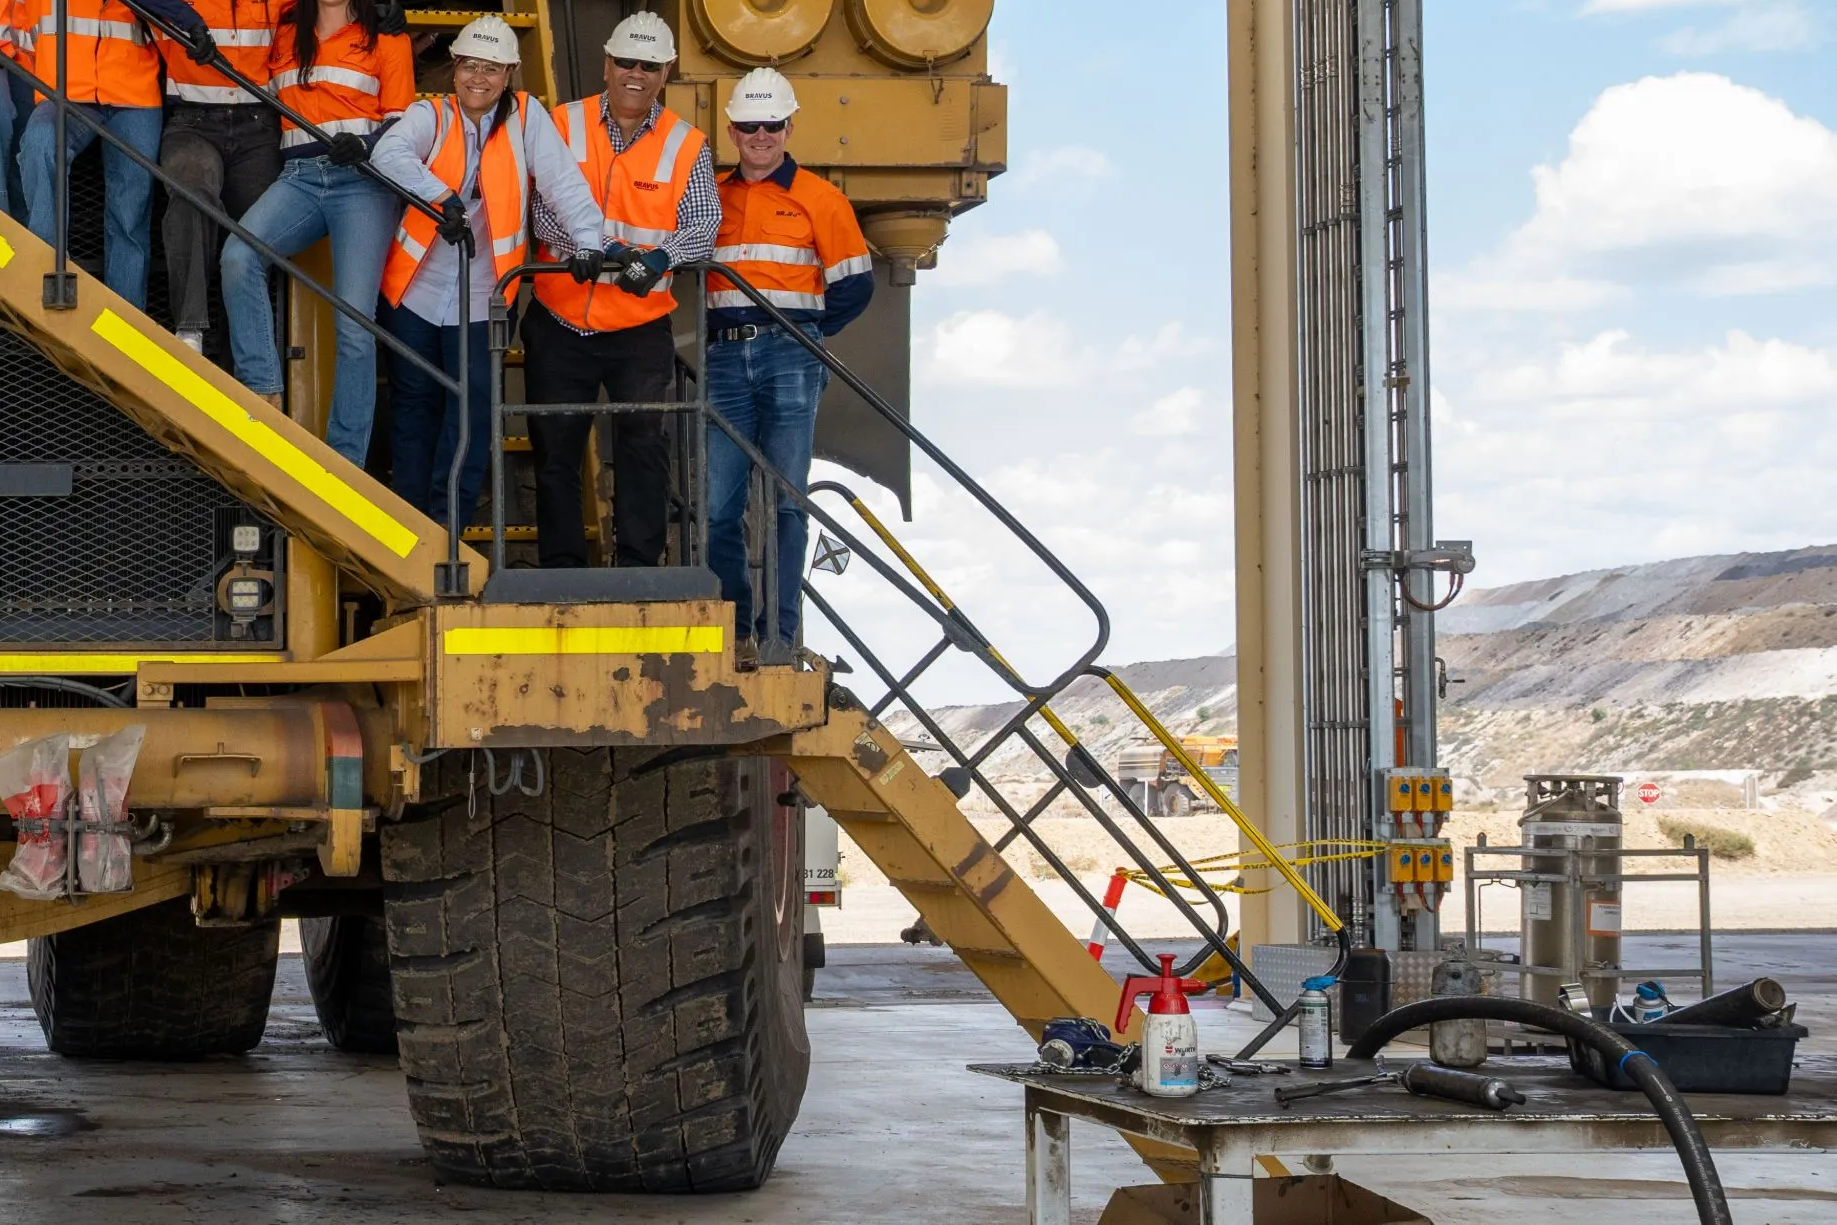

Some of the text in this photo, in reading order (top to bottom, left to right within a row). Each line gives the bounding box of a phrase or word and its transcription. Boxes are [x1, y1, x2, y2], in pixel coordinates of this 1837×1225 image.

[473, 33, 499, 43] BRAVUS
[629, 33, 656, 42] BRAVUS
[633, 180, 659, 189] BRAVUS
[1638, 788, 1660, 797] STOP
[817, 869, 835, 879] 228
